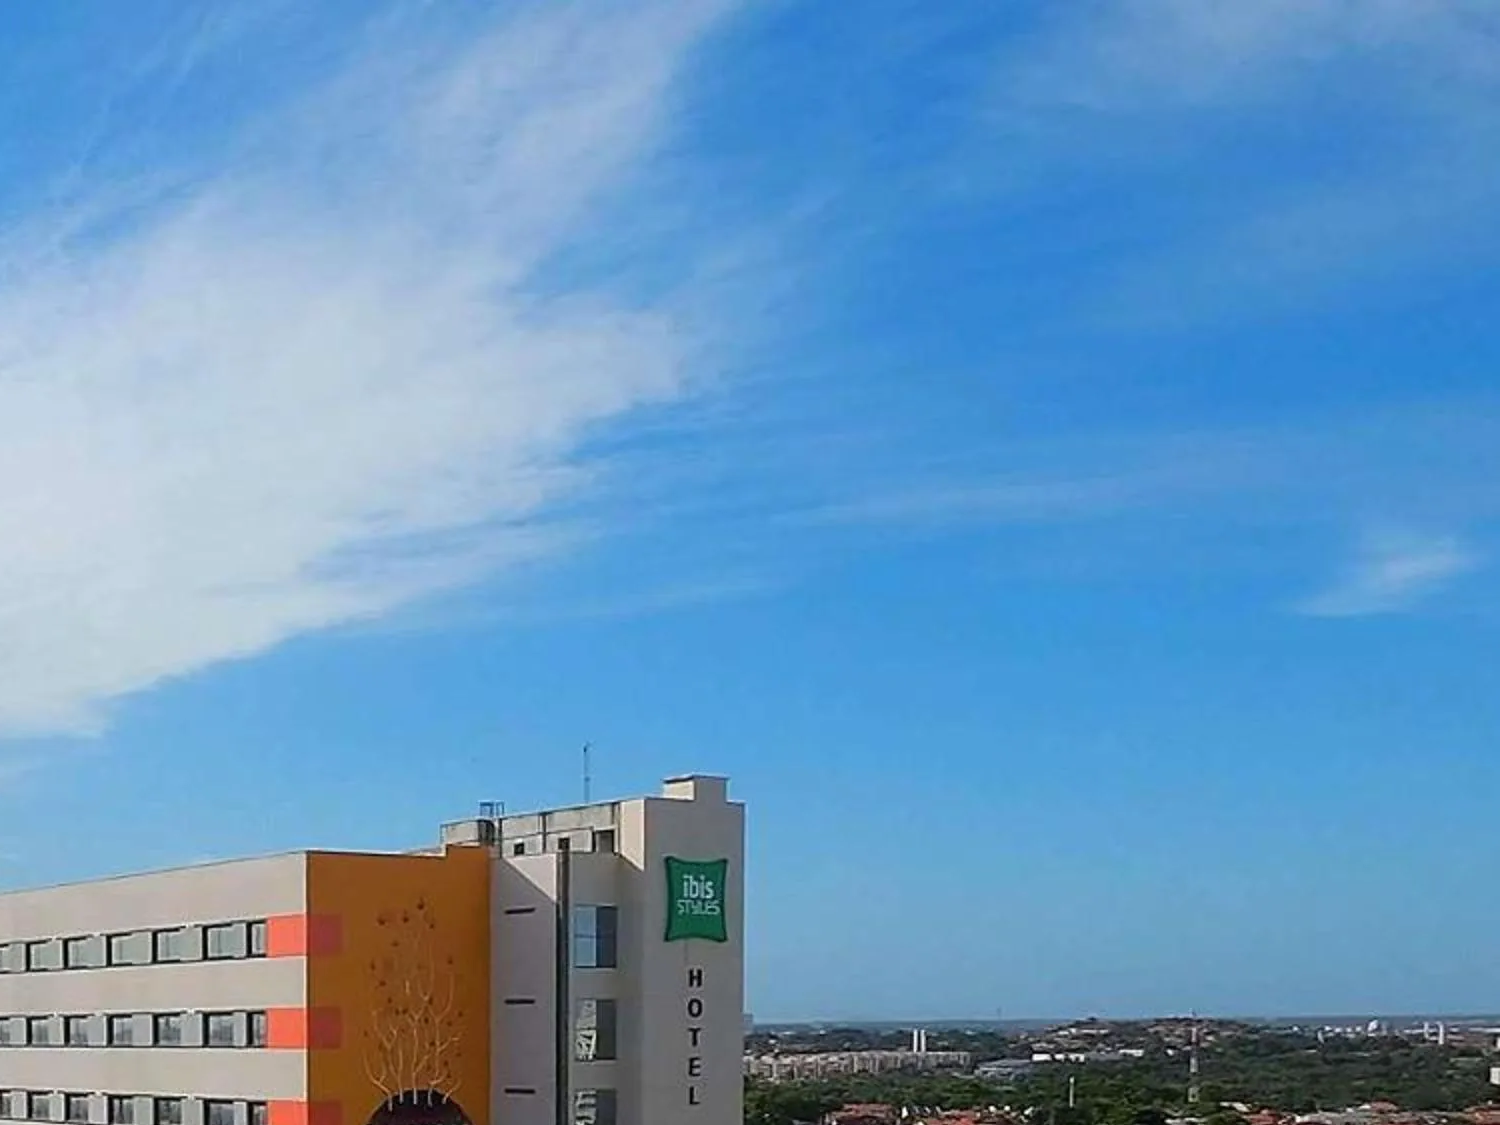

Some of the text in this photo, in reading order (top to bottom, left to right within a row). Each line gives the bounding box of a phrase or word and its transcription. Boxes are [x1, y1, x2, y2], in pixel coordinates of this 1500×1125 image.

[683, 874, 714, 899] ibis
[676, 899, 721, 916] STYLES
[687, 968, 703, 1106] HOTEL
